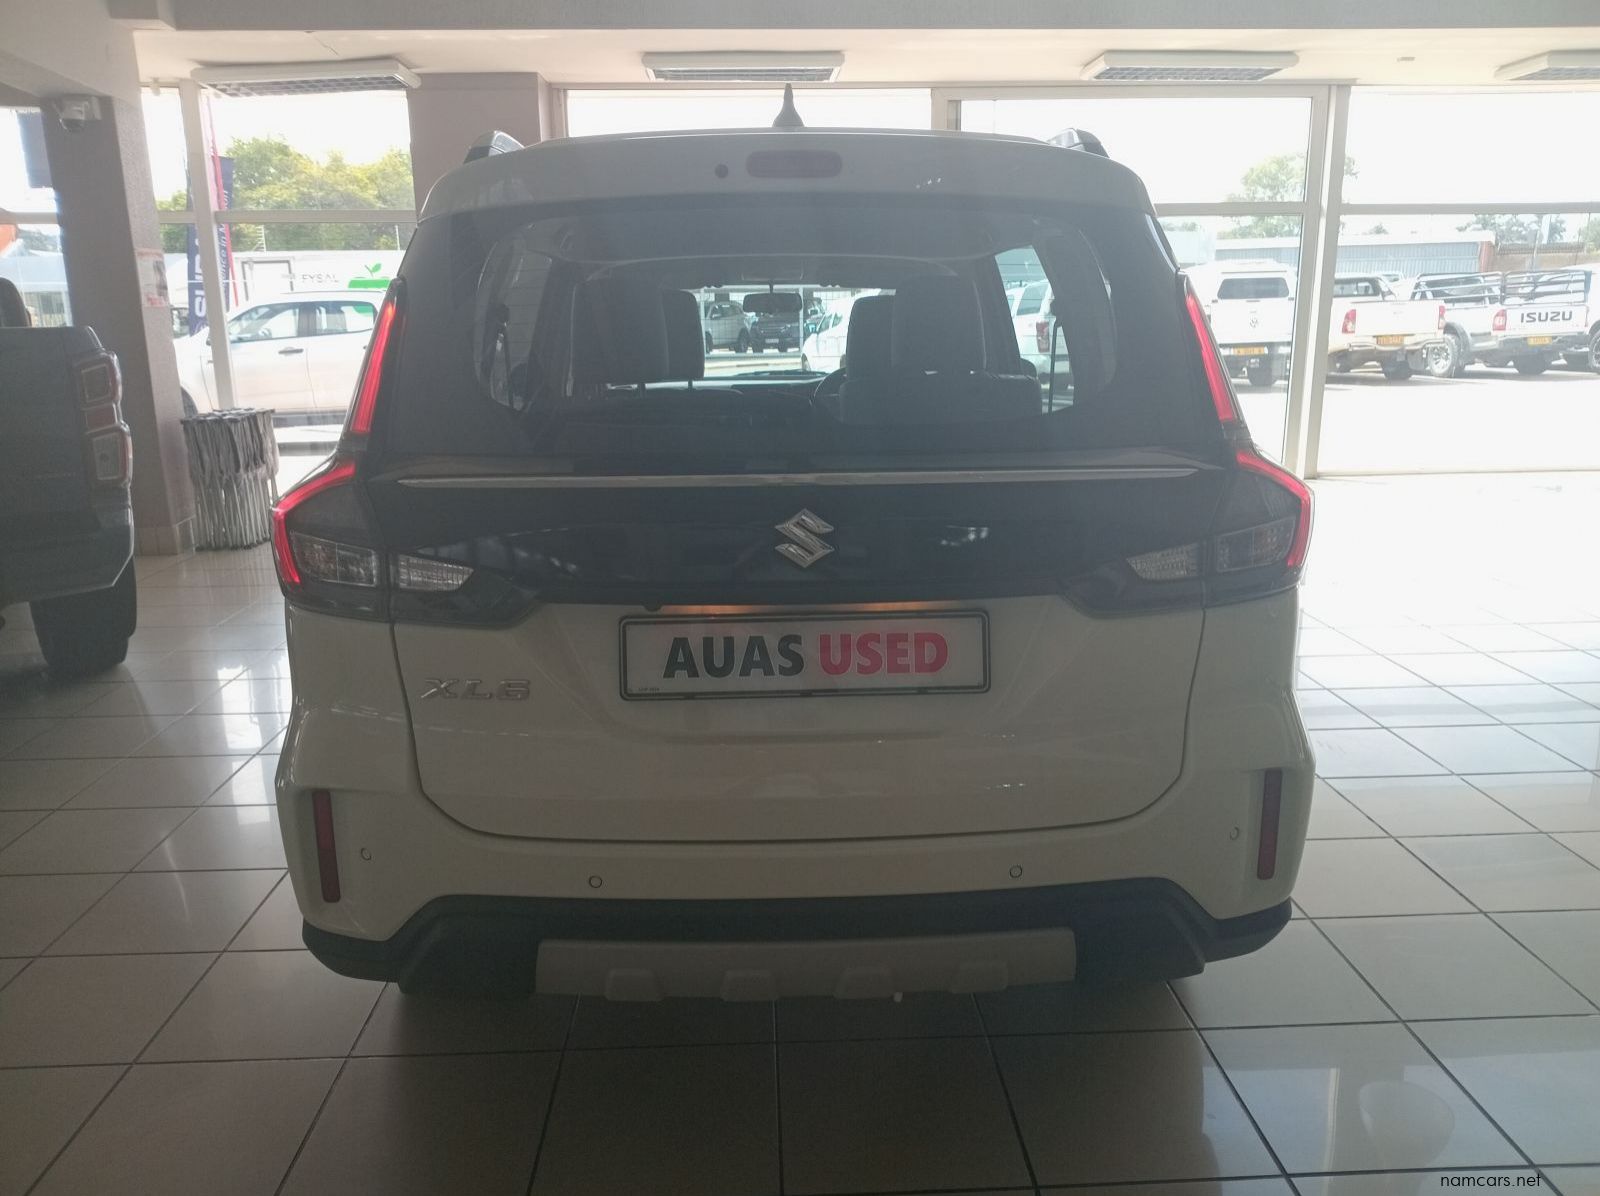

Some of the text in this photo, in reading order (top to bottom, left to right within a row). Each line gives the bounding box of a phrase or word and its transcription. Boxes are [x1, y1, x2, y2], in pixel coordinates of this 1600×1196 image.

[1520, 310, 1573, 323] ISUZU
[662, 631, 949, 679] AUAS USED
[419, 678, 530, 700] XL6
